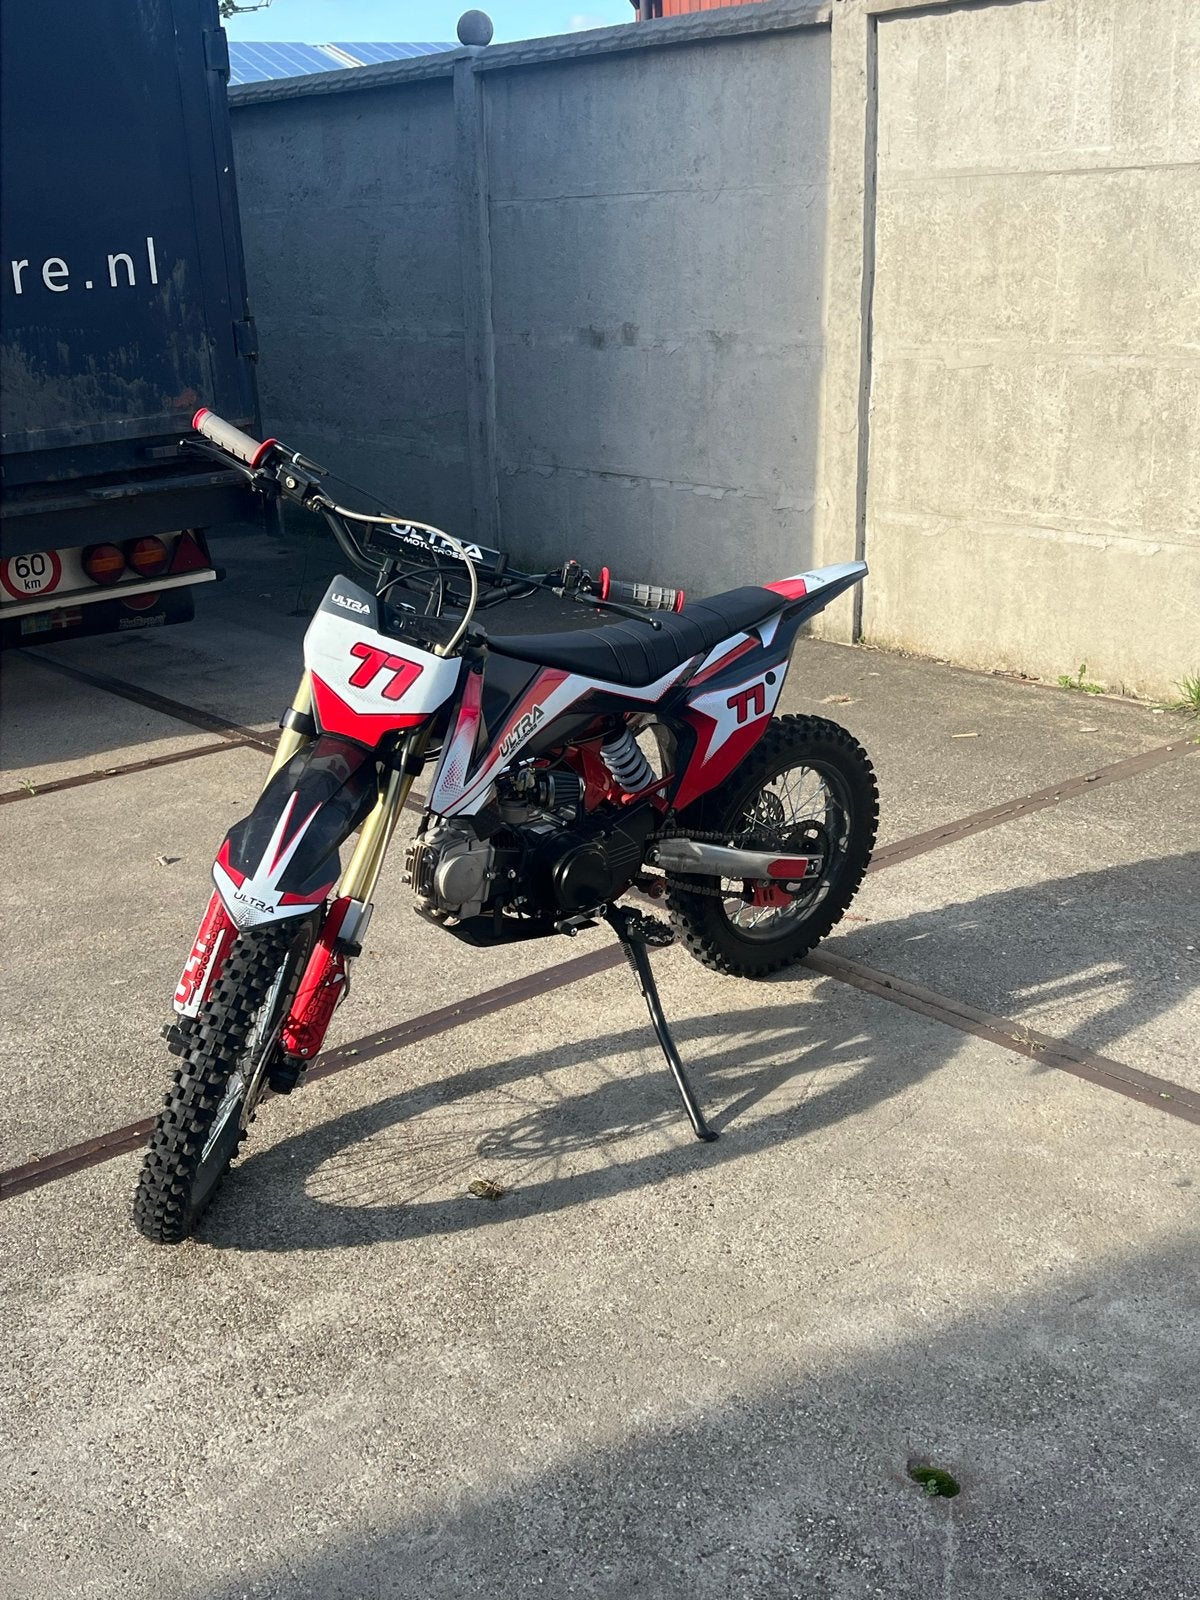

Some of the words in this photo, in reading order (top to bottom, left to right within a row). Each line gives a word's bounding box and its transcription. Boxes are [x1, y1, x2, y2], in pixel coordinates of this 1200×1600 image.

[11, 237, 158, 294] re.nl
[15, 553, 45, 577] 60
[24, 577, 41, 590] km
[331, 593, 370, 614] ULTRA
[349, 642, 424, 701] 77
[728, 682, 765, 724] 77
[500, 705, 544, 757] ULTRA
[233, 891, 275, 914] ULTRA
[174, 930, 211, 1004] ULT
